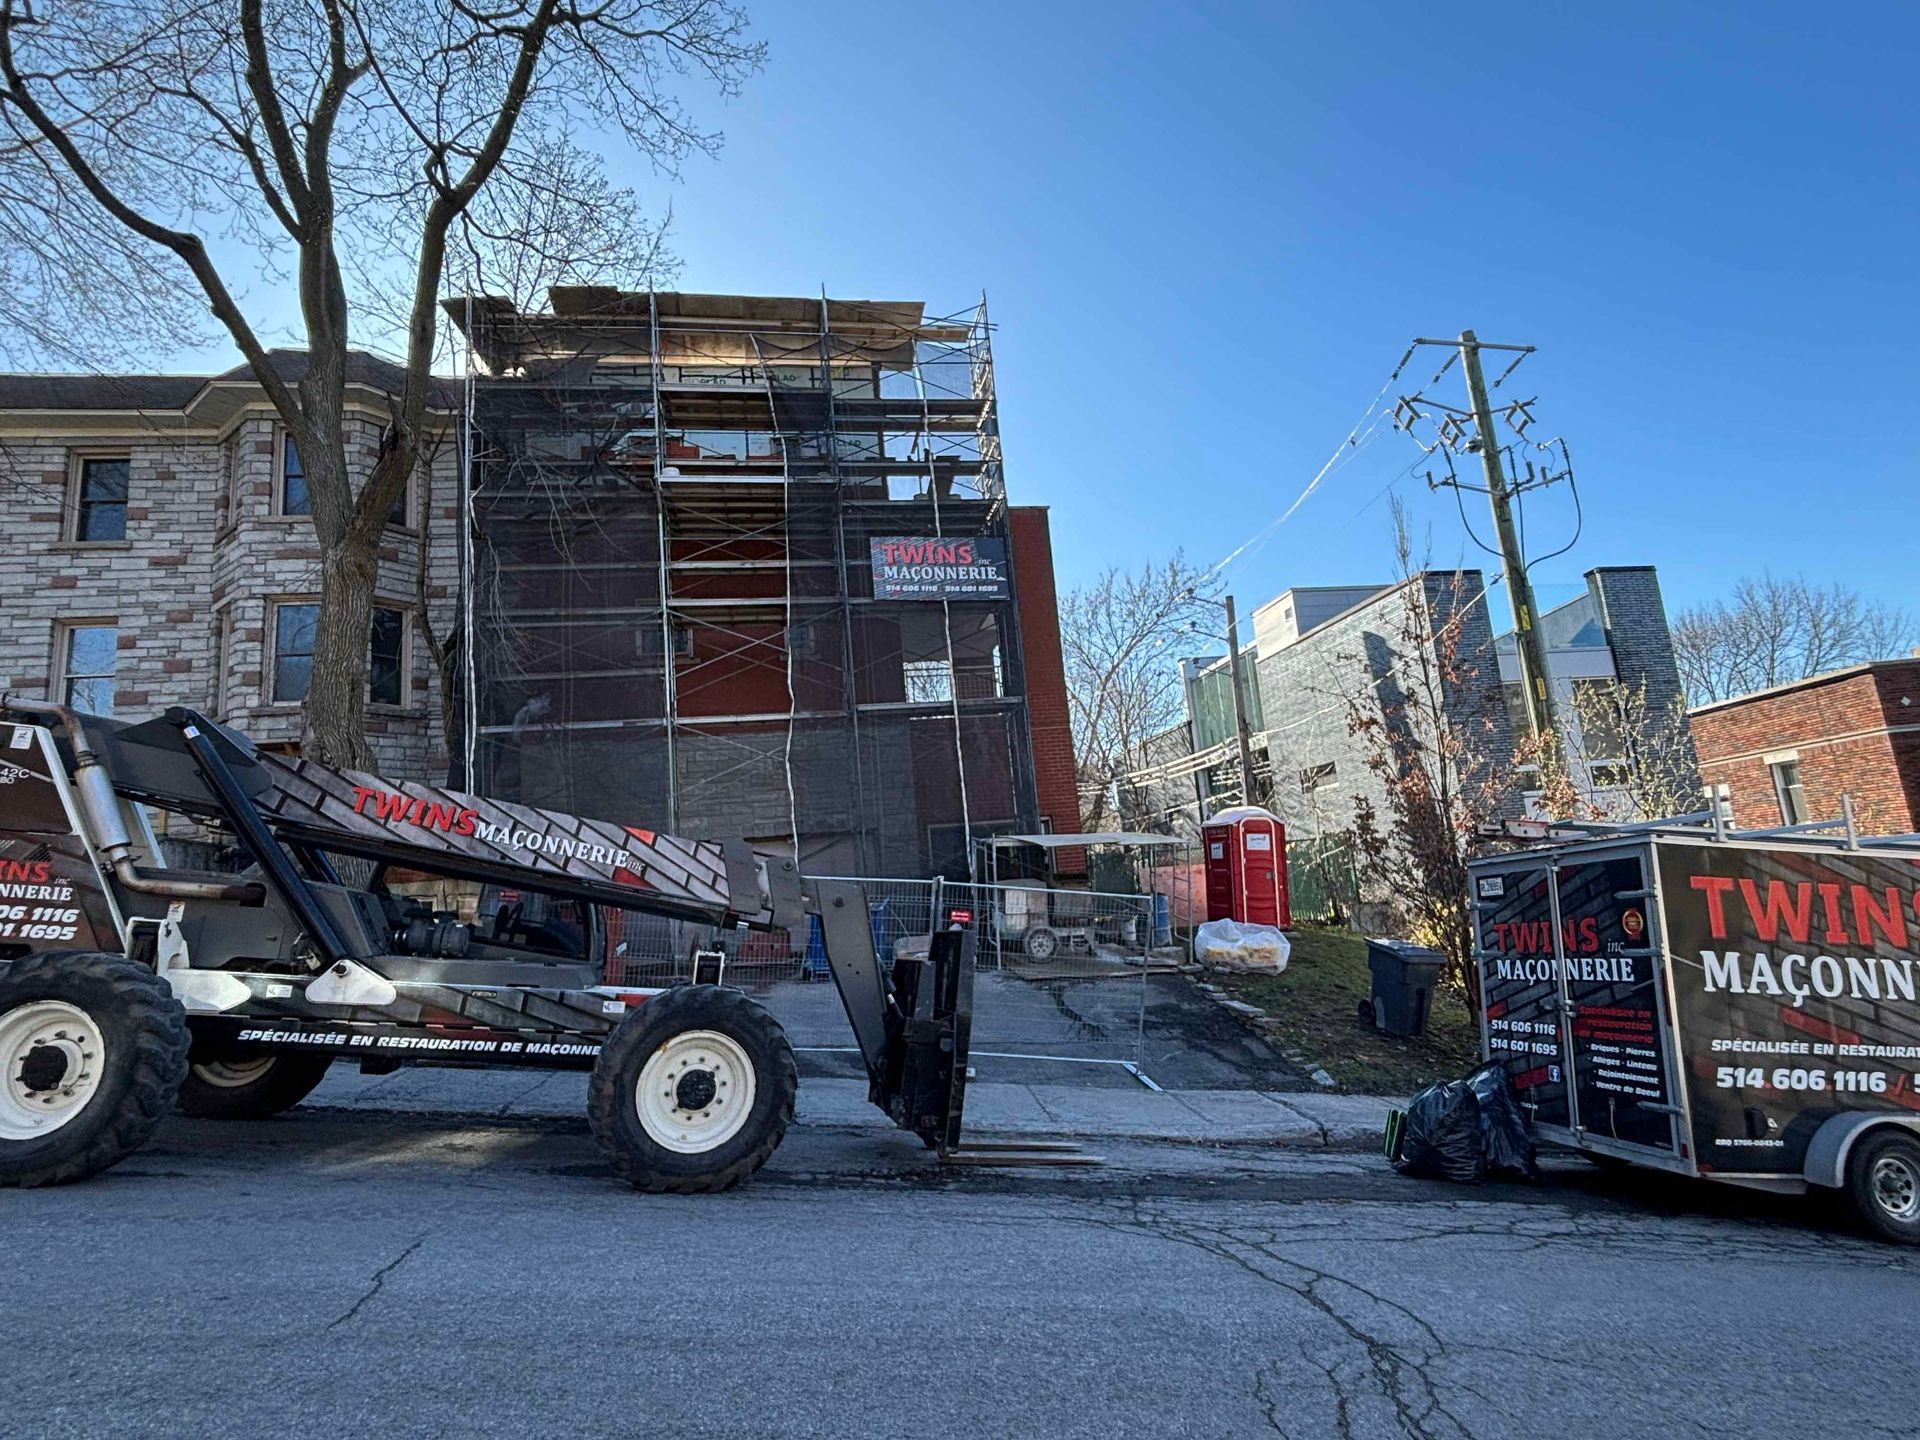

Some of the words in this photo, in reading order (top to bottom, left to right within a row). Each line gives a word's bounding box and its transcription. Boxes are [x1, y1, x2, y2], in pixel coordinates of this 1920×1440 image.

[881, 541, 973, 565] TWINS
[978, 557, 991, 565] inc
[884, 566, 998, 582] MAÇONNERIE
[352, 787, 479, 836] TWINS
[474, 822, 630, 868] MAÇONNERIE
[54, 876, 71, 885] inc
[1689, 876, 1920, 948] TWIN
[1493, 917, 1600, 956] TWINS
[1699, 950, 1920, 1008] MAÇONN
[1491, 1019, 1508, 1030] 514
[1511, 1021, 1532, 1033] 606
[1534, 1023, 1556, 1035] 1116
[237, 1028, 347, 1045] SPÉCIALISÉE
[349, 1034, 374, 1047] EN
[377, 1036, 498, 1052] RESTAURATION
[500, 1041, 522, 1053] DE
[1491, 1038, 1508, 1049] 514
[1510, 1040, 1529, 1052] 601
[1531, 1042, 1557, 1056] 1695
[1711, 1037, 1809, 1055] SPÉCIALISÉE
[1813, 1043, 1834, 1055] EN
[1590, 1043, 1620, 1053] Briques
[1625, 1047, 1656, 1057] Pierres
[1626, 1059, 1657, 1071] Linteau
[1596, 1081, 1621, 1091] Ventre
[1623, 1085, 1634, 1094] de
